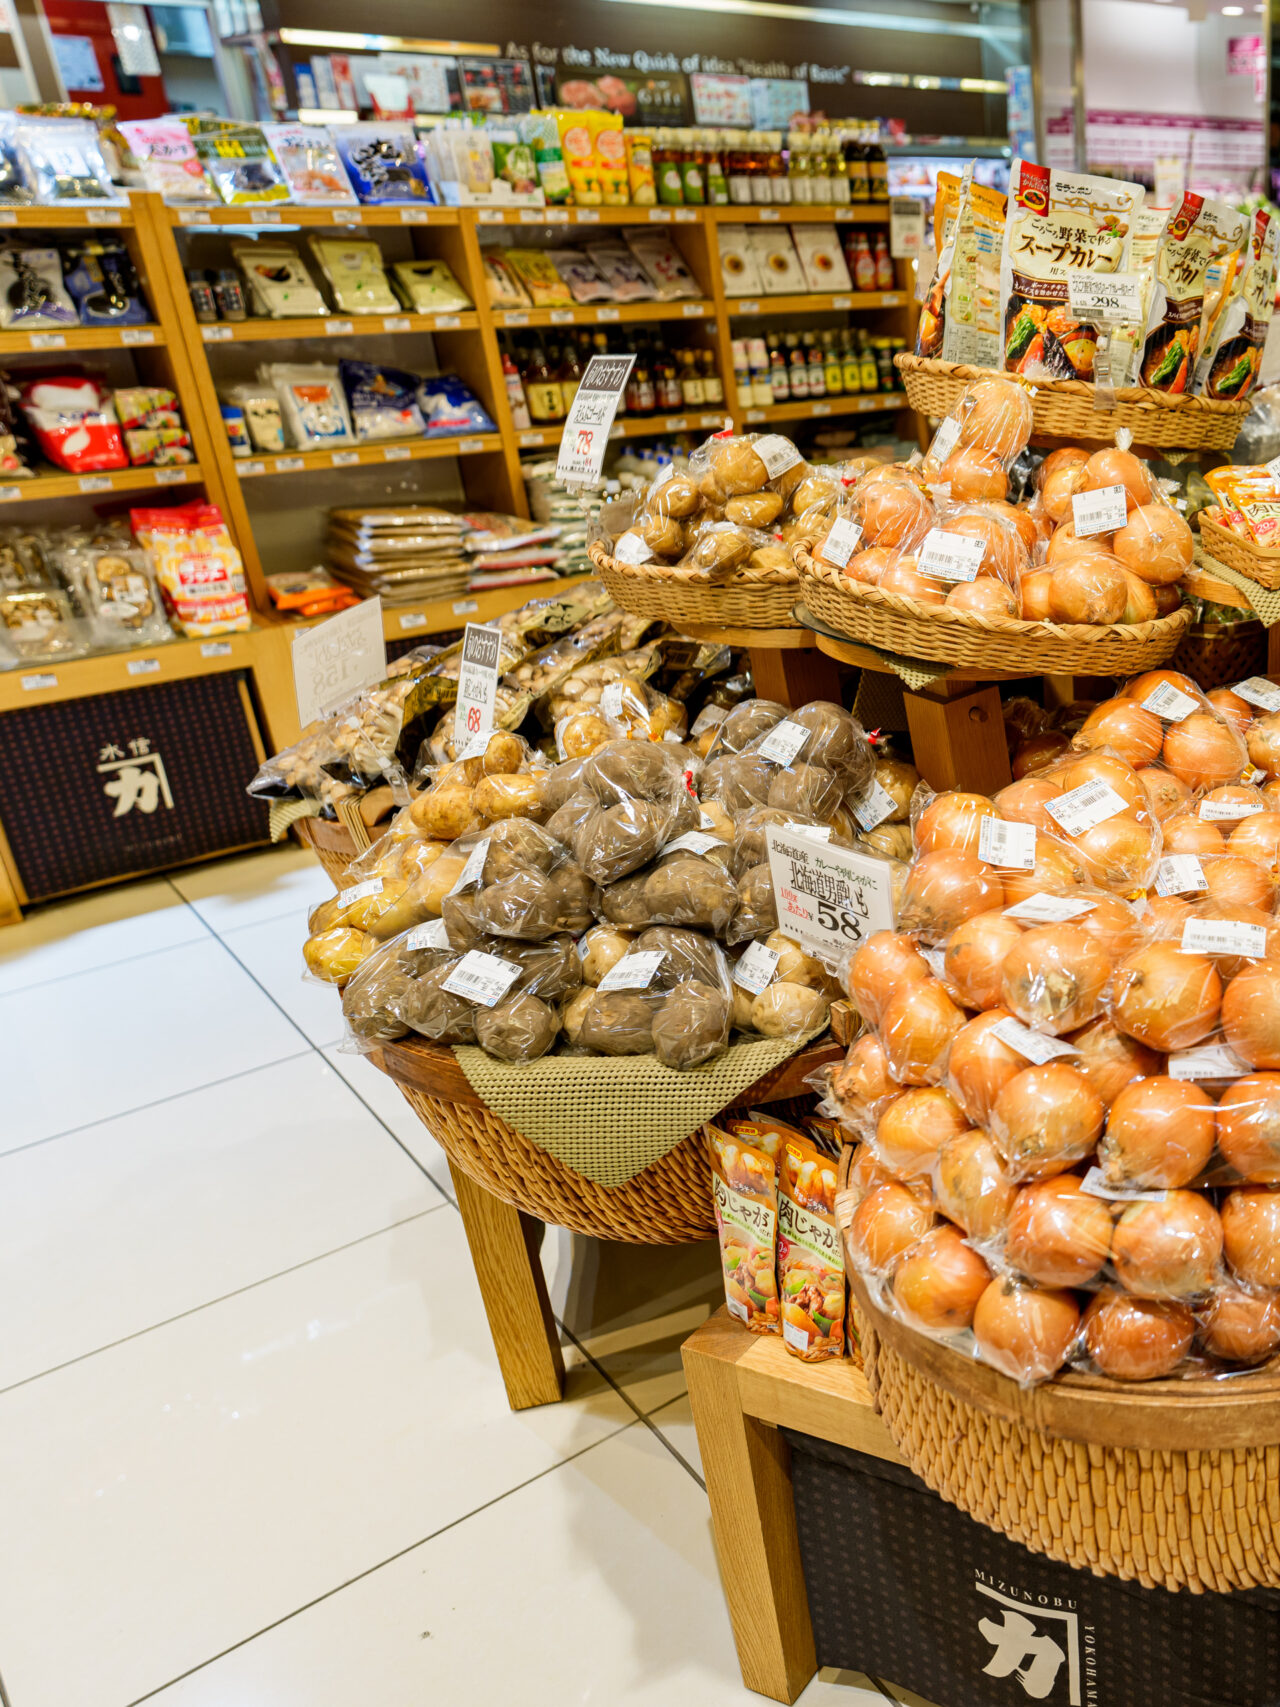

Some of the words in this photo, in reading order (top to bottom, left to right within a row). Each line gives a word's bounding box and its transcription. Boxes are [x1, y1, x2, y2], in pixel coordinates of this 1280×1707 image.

[506, 42, 528, 59] As
[533, 42, 557, 63] for
[563, 46, 590, 66] the
[595, 48, 630, 69] New
[634, 50, 679, 73] Quick
[682, 54, 699, 73] of
[796, 62, 807, 78] of
[1055, 182, 1092, 195] モランボン
[1019, 233, 1113, 268] スープカレー
[772, 840, 809, 864] 北海道産
[790, 861, 868, 916] 北海道男爵いも
[715, 1179, 769, 1228] 肉じゃが
[975, 1568, 1077, 1609] MIZUNOBU
[978, 1610, 1066, 1699] 力
[1084, 1625, 1098, 1707] YOKOHAMA
